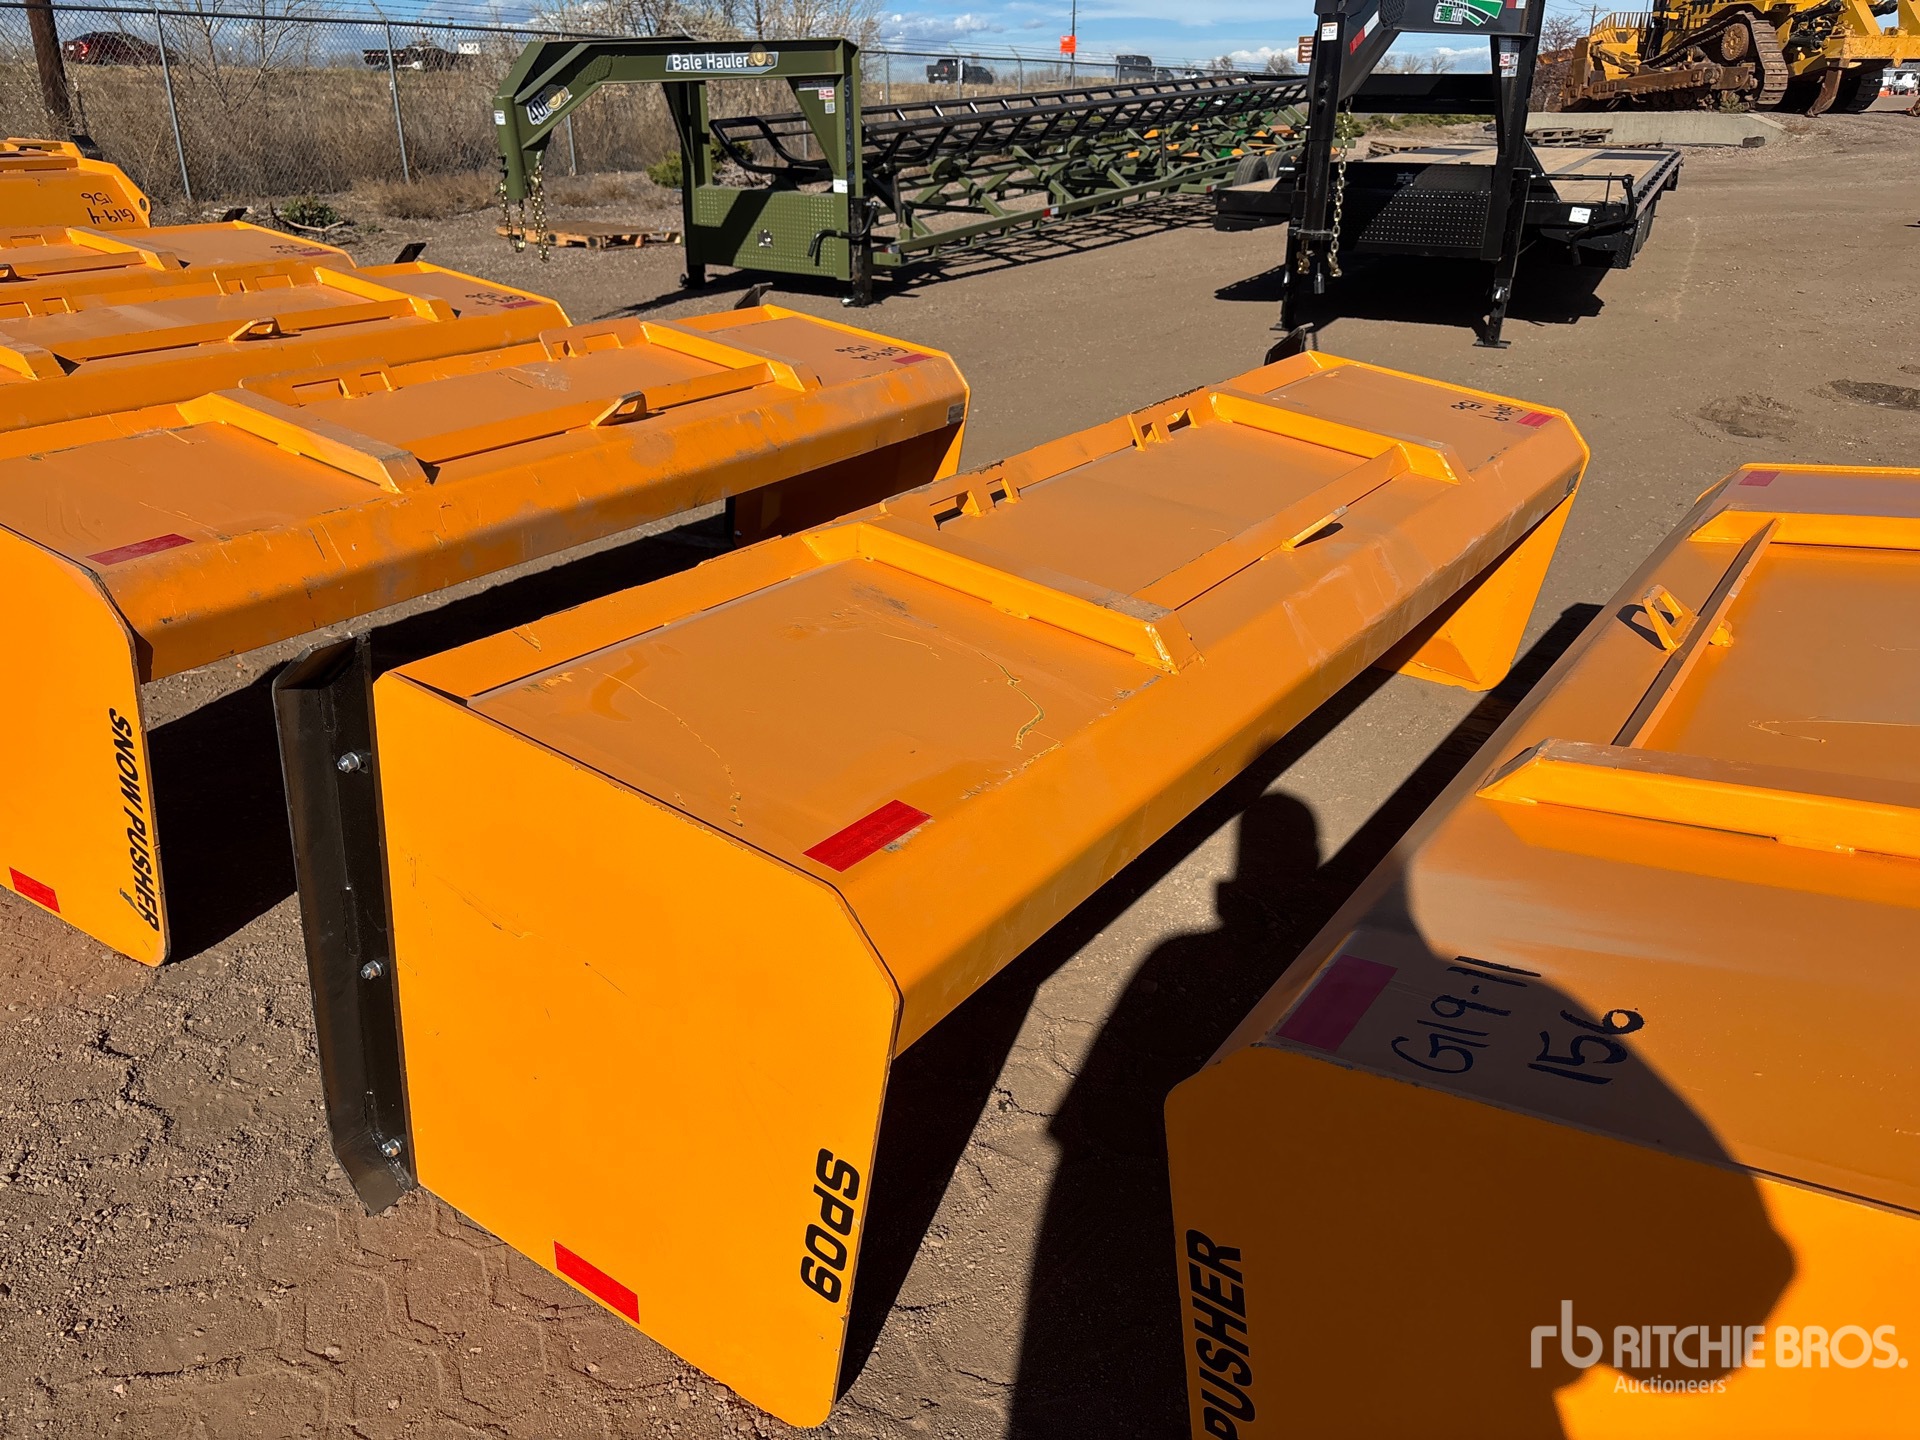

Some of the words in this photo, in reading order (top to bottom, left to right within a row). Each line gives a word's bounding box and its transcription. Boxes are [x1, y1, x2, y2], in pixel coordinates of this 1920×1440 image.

[672, 54, 702, 70] Bale
[705, 53, 749, 68] Hauler
[81, 192, 113, 205] 156
[87, 207, 135, 224] G19-4
[835, 345, 871, 354] 156
[1450, 400, 1486, 411] 156
[109, 708, 144, 813] SNOW
[123, 805, 160, 932] PUSHER
[1391, 955, 1541, 1074] G19-11
[1527, 1008, 1645, 1085] 156
[800, 1148, 860, 1303] SP09
[1186, 1229, 1256, 1440] PUSHER
